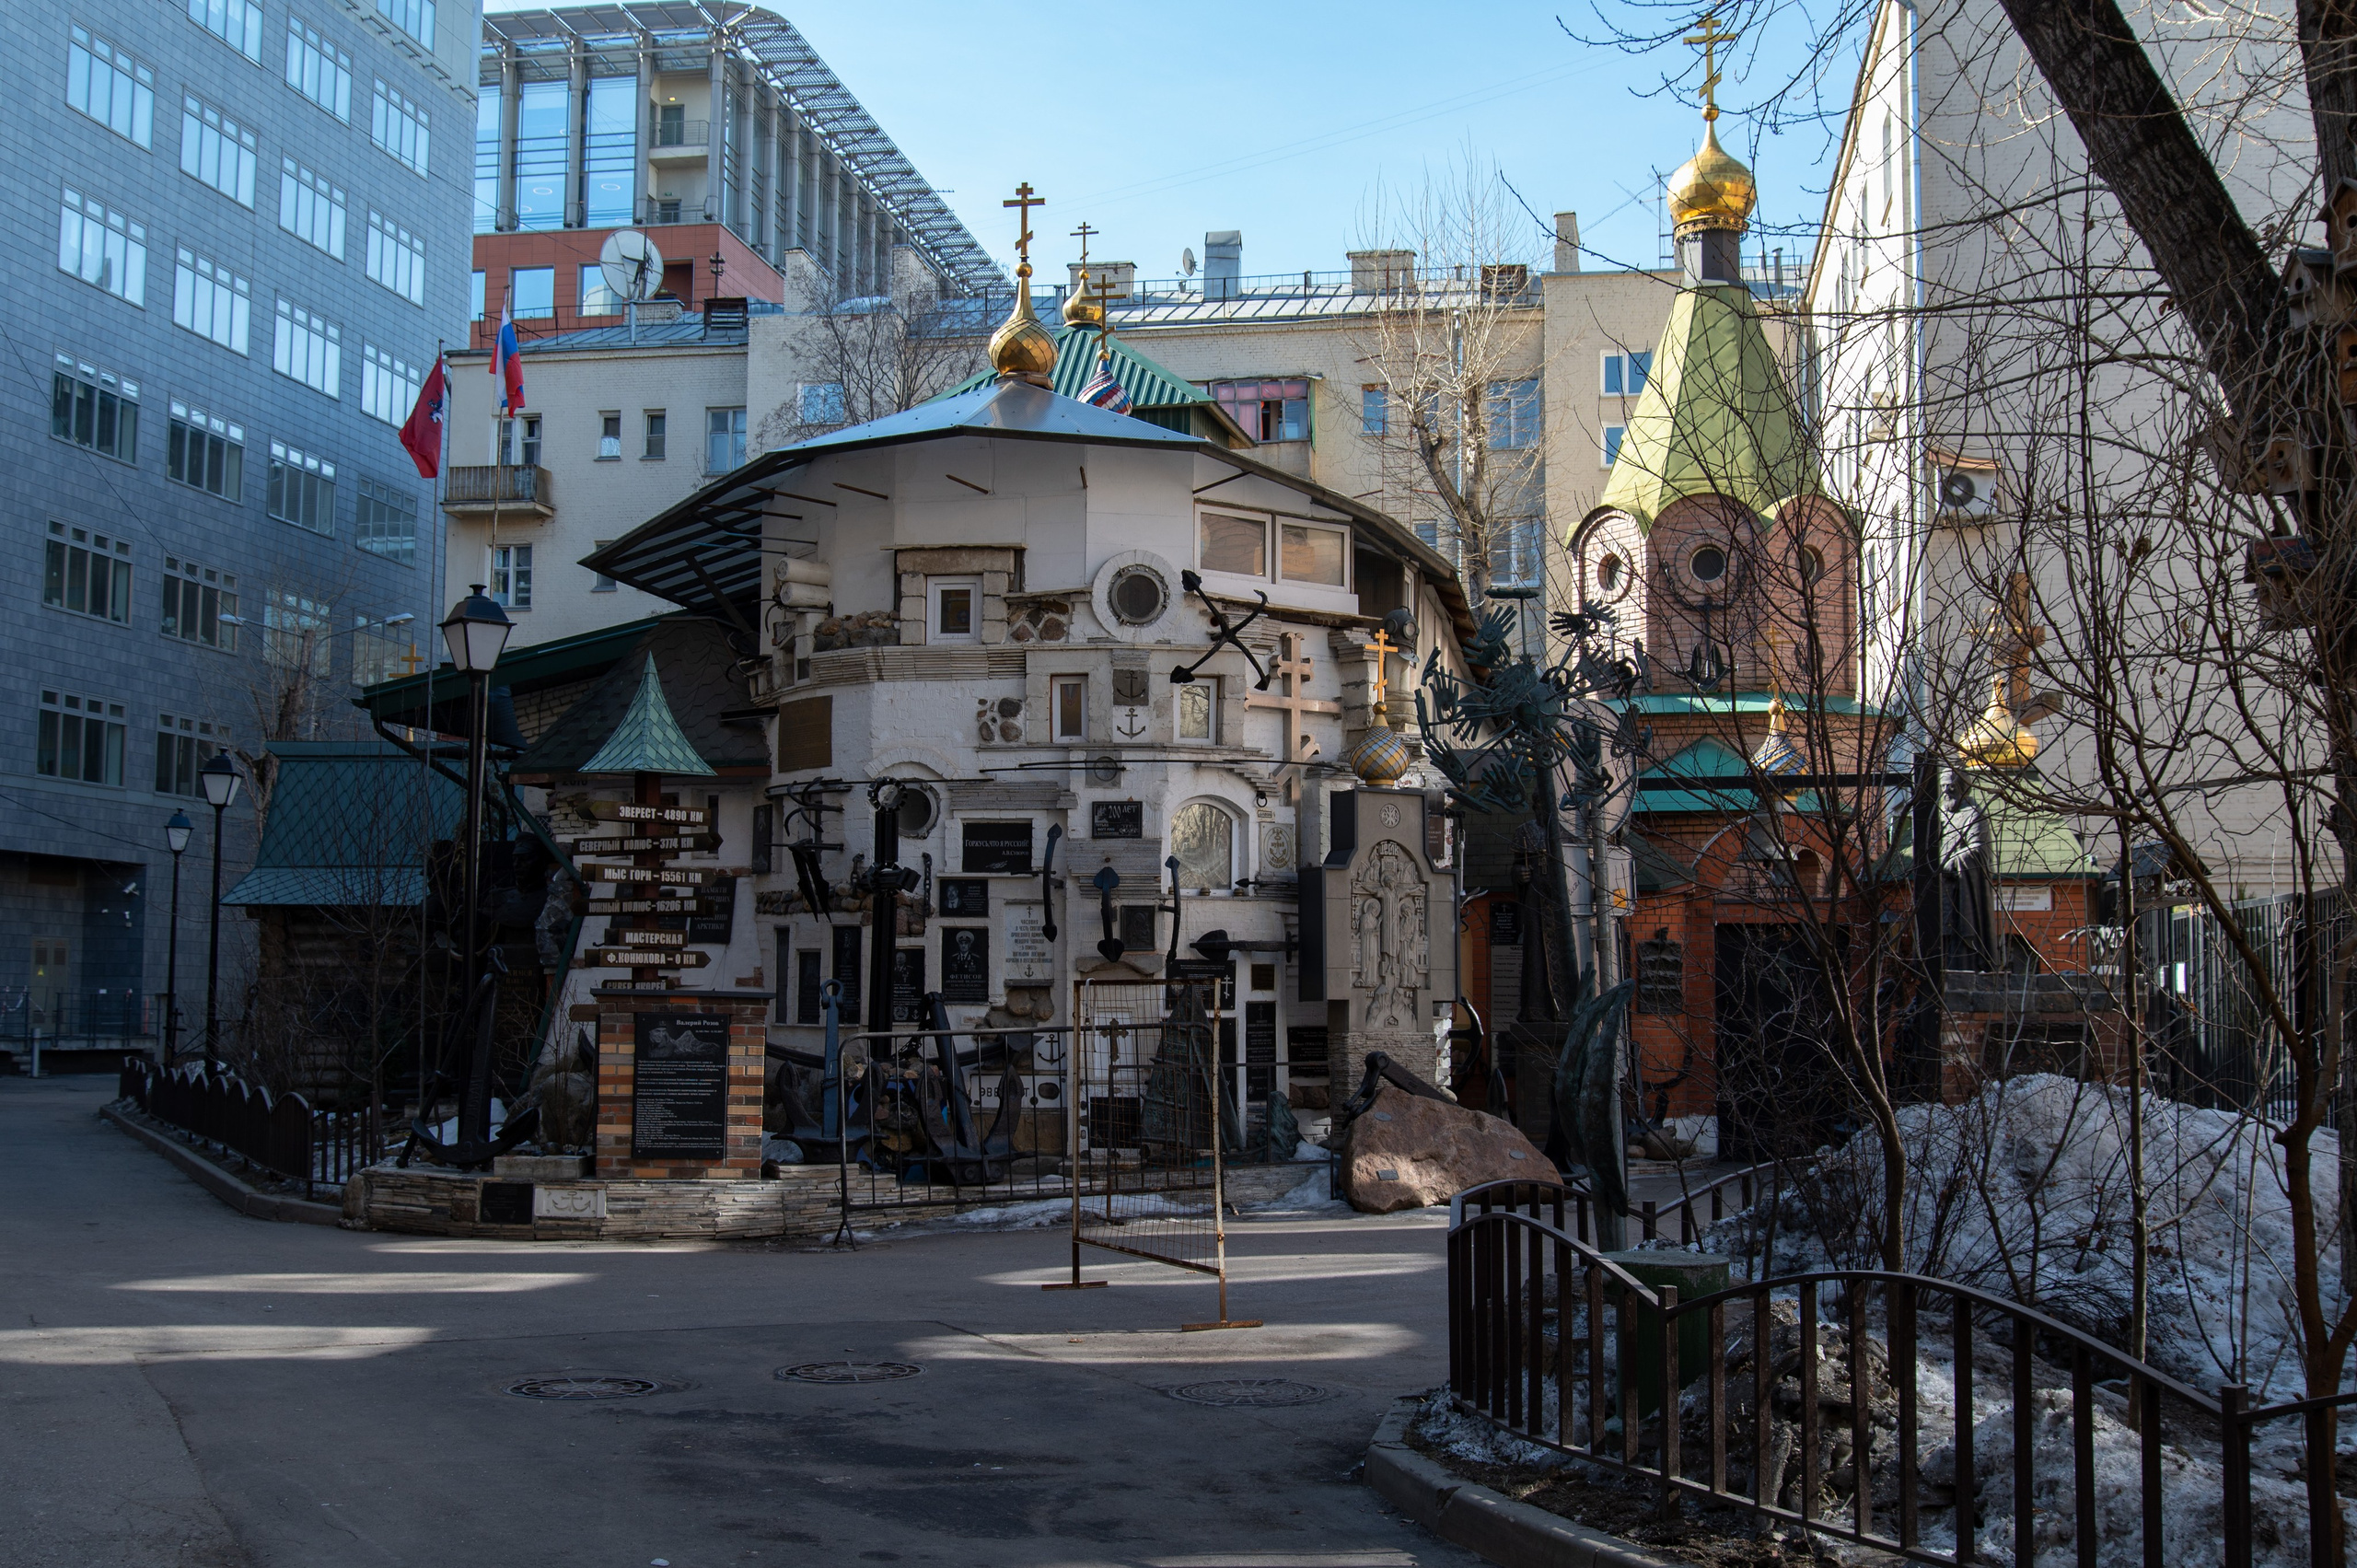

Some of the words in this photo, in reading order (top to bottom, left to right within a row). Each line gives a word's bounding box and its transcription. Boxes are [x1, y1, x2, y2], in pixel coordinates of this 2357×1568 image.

[619, 806, 656, 819] ЭВЕРЕСТ
[664, 808, 687, 821] 4890
[690, 810, 703, 823] КМ
[578, 837, 621, 853] СЕВЕРНЫЙ
[623, 838, 652, 851] ПОЛЮС
[659, 838, 679, 849] 3774
[681, 837, 694, 849] КМ
[604, 868, 626, 880] МЫС
[630, 869, 652, 881] ГОРН
[660, 870, 686, 882] 15561
[689, 872, 702, 884] КМ
[588, 900, 621, 913] ЮЖНЫЙ
[684, 900, 697, 912] КМ
[625, 932, 683, 946] МАСТЕРСКАЯ
[607, 952, 666, 965] Ф.КОНЮХОВА
[675, 954, 680, 964] 0
[683, 954, 696, 965] КМ
